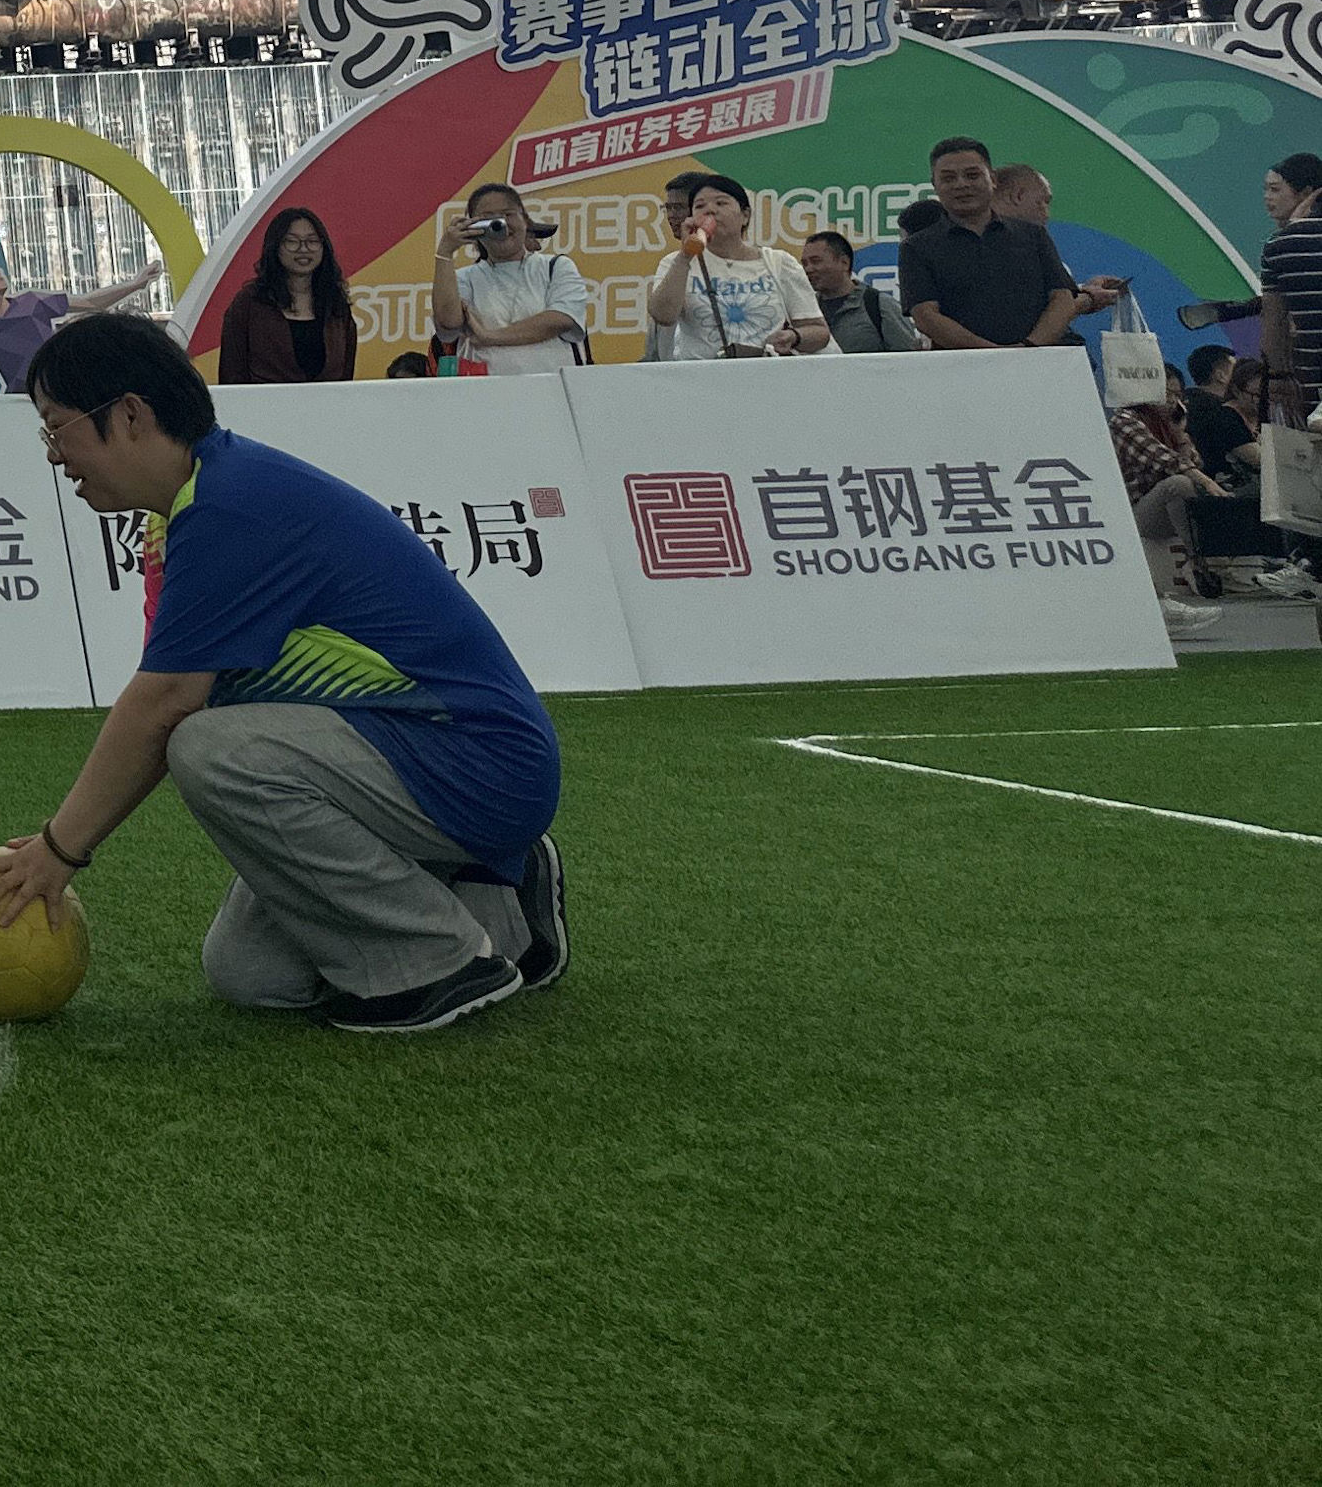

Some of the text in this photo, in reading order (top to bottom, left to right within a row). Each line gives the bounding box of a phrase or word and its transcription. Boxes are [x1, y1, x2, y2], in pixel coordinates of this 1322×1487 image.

[533, 87, 778, 177] 体育服务专题展
[751, 458, 1105, 541] 首钢基金
[772, 538, 1115, 577] SHOUGANG FUND
